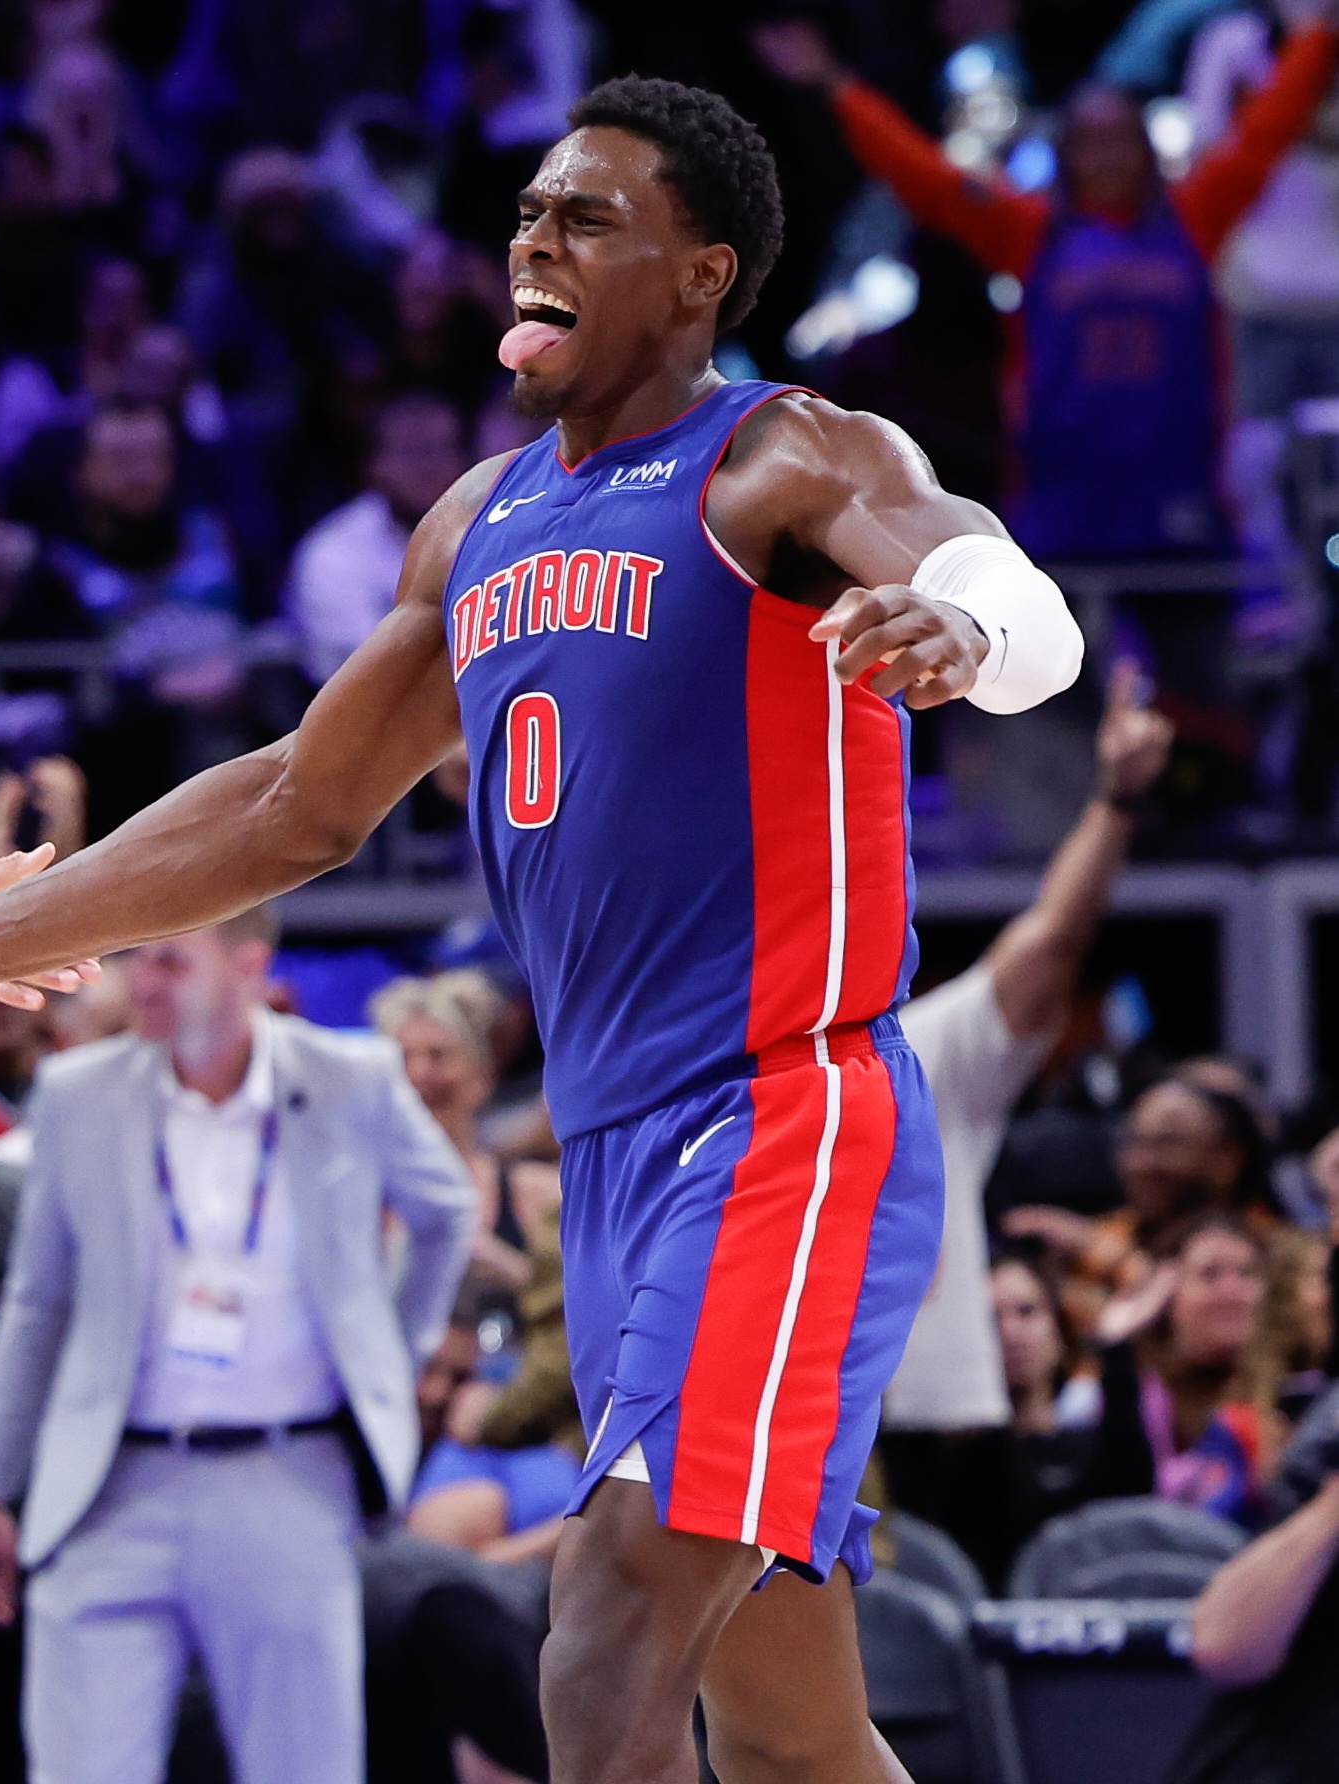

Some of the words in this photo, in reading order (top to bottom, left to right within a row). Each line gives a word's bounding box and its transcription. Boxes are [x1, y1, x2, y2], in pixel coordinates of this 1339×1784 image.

[609, 458, 678, 487] UWM
[453, 549, 664, 684] DETROIT
[505, 691, 561, 830] 0
